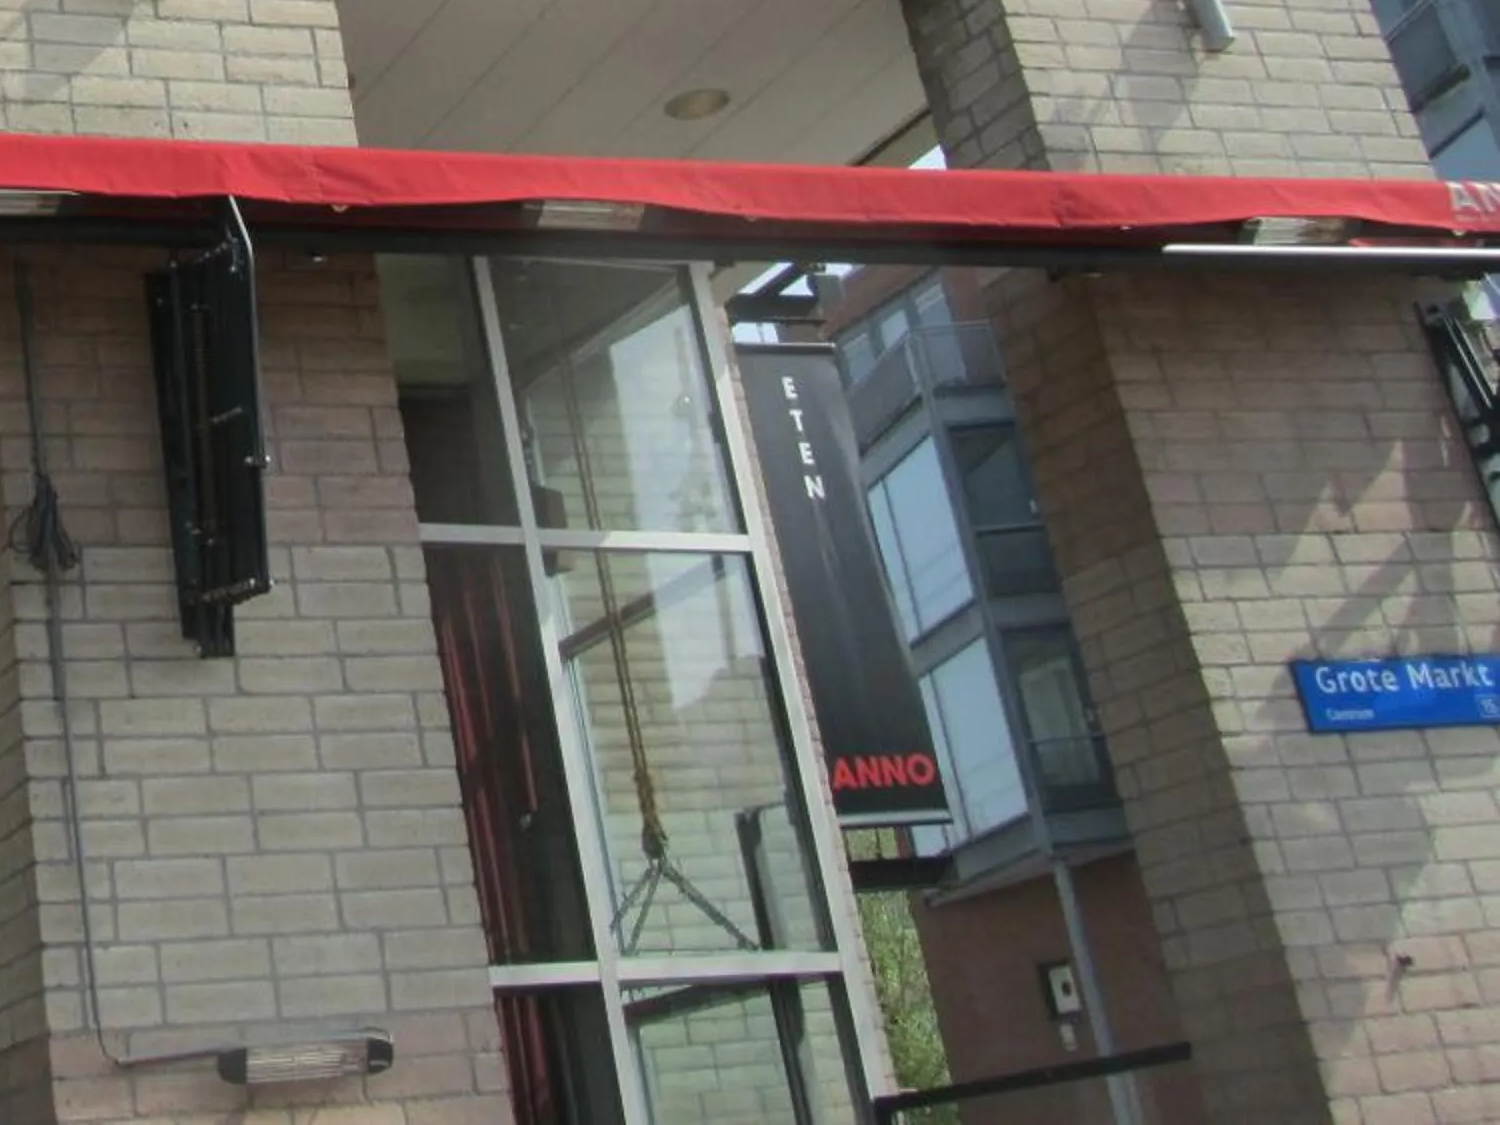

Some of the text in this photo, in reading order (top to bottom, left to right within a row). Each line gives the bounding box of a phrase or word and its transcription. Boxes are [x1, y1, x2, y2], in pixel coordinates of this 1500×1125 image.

[781, 376, 825, 499] ETEN
[1315, 661, 1495, 694] Grote Markt
[832, 753, 935, 789] ANNO
